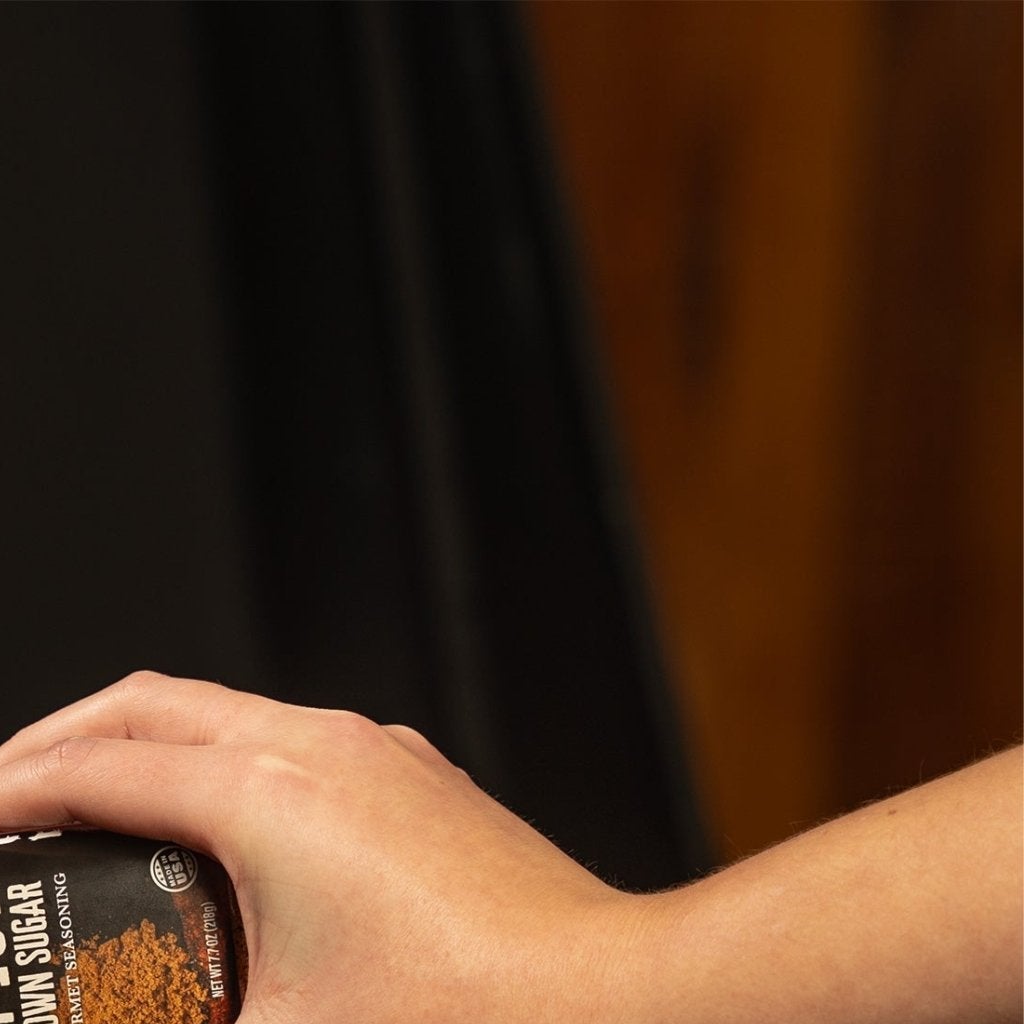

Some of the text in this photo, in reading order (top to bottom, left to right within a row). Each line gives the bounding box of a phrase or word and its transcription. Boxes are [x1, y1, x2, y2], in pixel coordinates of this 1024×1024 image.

[160, 855, 177, 888] MADE IN
[168, 851, 188, 885] USA
[7, 880, 52, 966] SUGAR
[53, 872, 77, 971] SEASONING
[200, 902, 225, 998] NET WT 7.7 OZ (218g)
